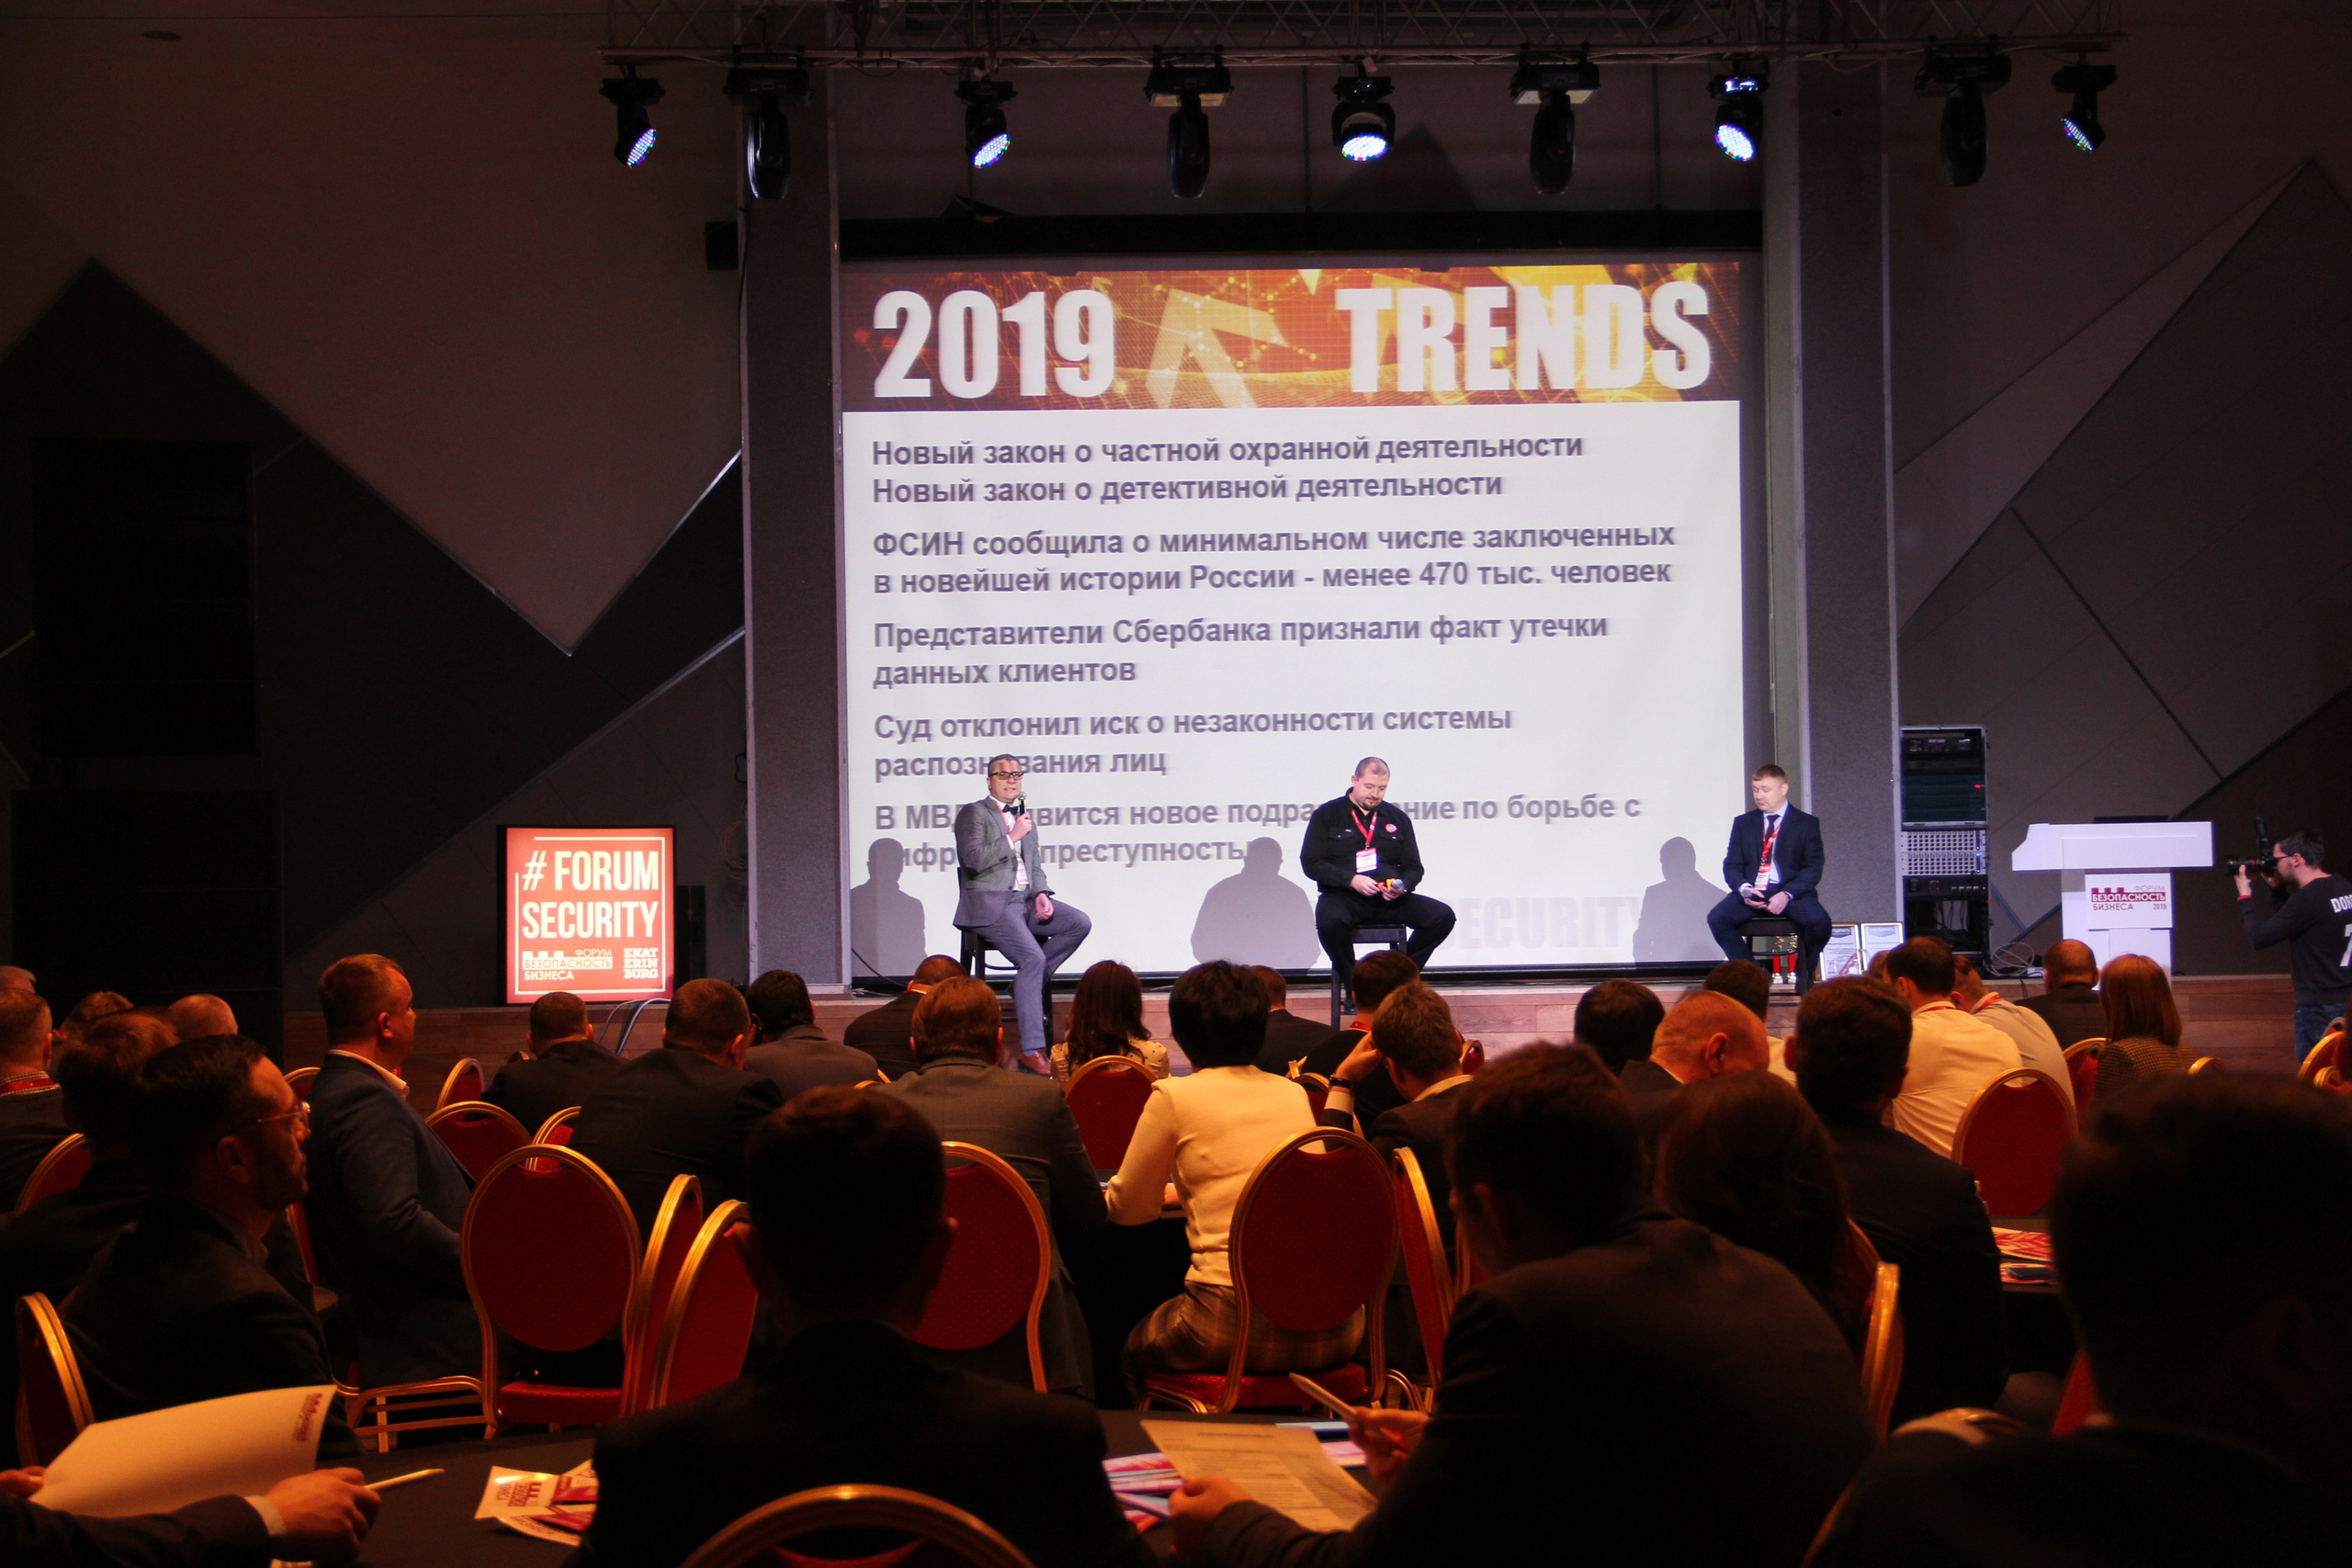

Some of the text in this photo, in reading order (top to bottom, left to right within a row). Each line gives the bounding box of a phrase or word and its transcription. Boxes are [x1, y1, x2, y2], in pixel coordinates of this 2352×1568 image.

[873, 280, 1712, 399] 2019 TRENDS
[873, 435, 1584, 468] Новый закон о частной охранной деятельности
[873, 474, 1503, 505] Новый закон о детективной деятельности
[873, 526, 1677, 558] ФСИН сообщила о минимальном числе заключенных
[874, 574, 892, 594] в
[901, 567, 1051, 593] новейшей
[1060, 570, 1182, 596] истории
[1190, 564, 1295, 589] России
[1323, 567, 1412, 587] менее
[1419, 561, 1469, 586] 470
[1476, 566, 1543, 585] тыс.
[1551, 563, 1672, 584] человек
[874, 615, 1609, 653] Представители Сбербанка признали факт утечки
[872, 662, 1137, 690] данных клиентов
[874, 710, 1512, 745] Суд отклонил иск о незаконности системы
[875, 752, 1168, 783] распознвания лиц
[876, 805, 897, 830] В
[906, 804, 974, 831] МВ
[1027, 807, 1120, 828] вится
[1129, 805, 1219, 825] новое
[1227, 800, 1455, 829] подрание
[1463, 800, 1499, 819] по
[1507, 793, 1617, 825] борьбе
[1623, 798, 1642, 818] с
[554, 850, 660, 891] FORUM
[1039, 840, 1250, 870] преступность
[2092, 893, 2165, 901] БЕЗОПАСНОСТЬ
[522, 900, 660, 939] SECURITY
[1441, 896, 1640, 950] ECURIT
[524, 958, 613, 969] БЕЗОПАСНОСТЬ
[574, 948, 613, 957] ФОРУМ
[623, 947, 659, 958] EKAT
[623, 958, 659, 968] ERIN
[524, 970, 574, 981] БИЗНЕСА
[623, 968, 659, 979] BURG
